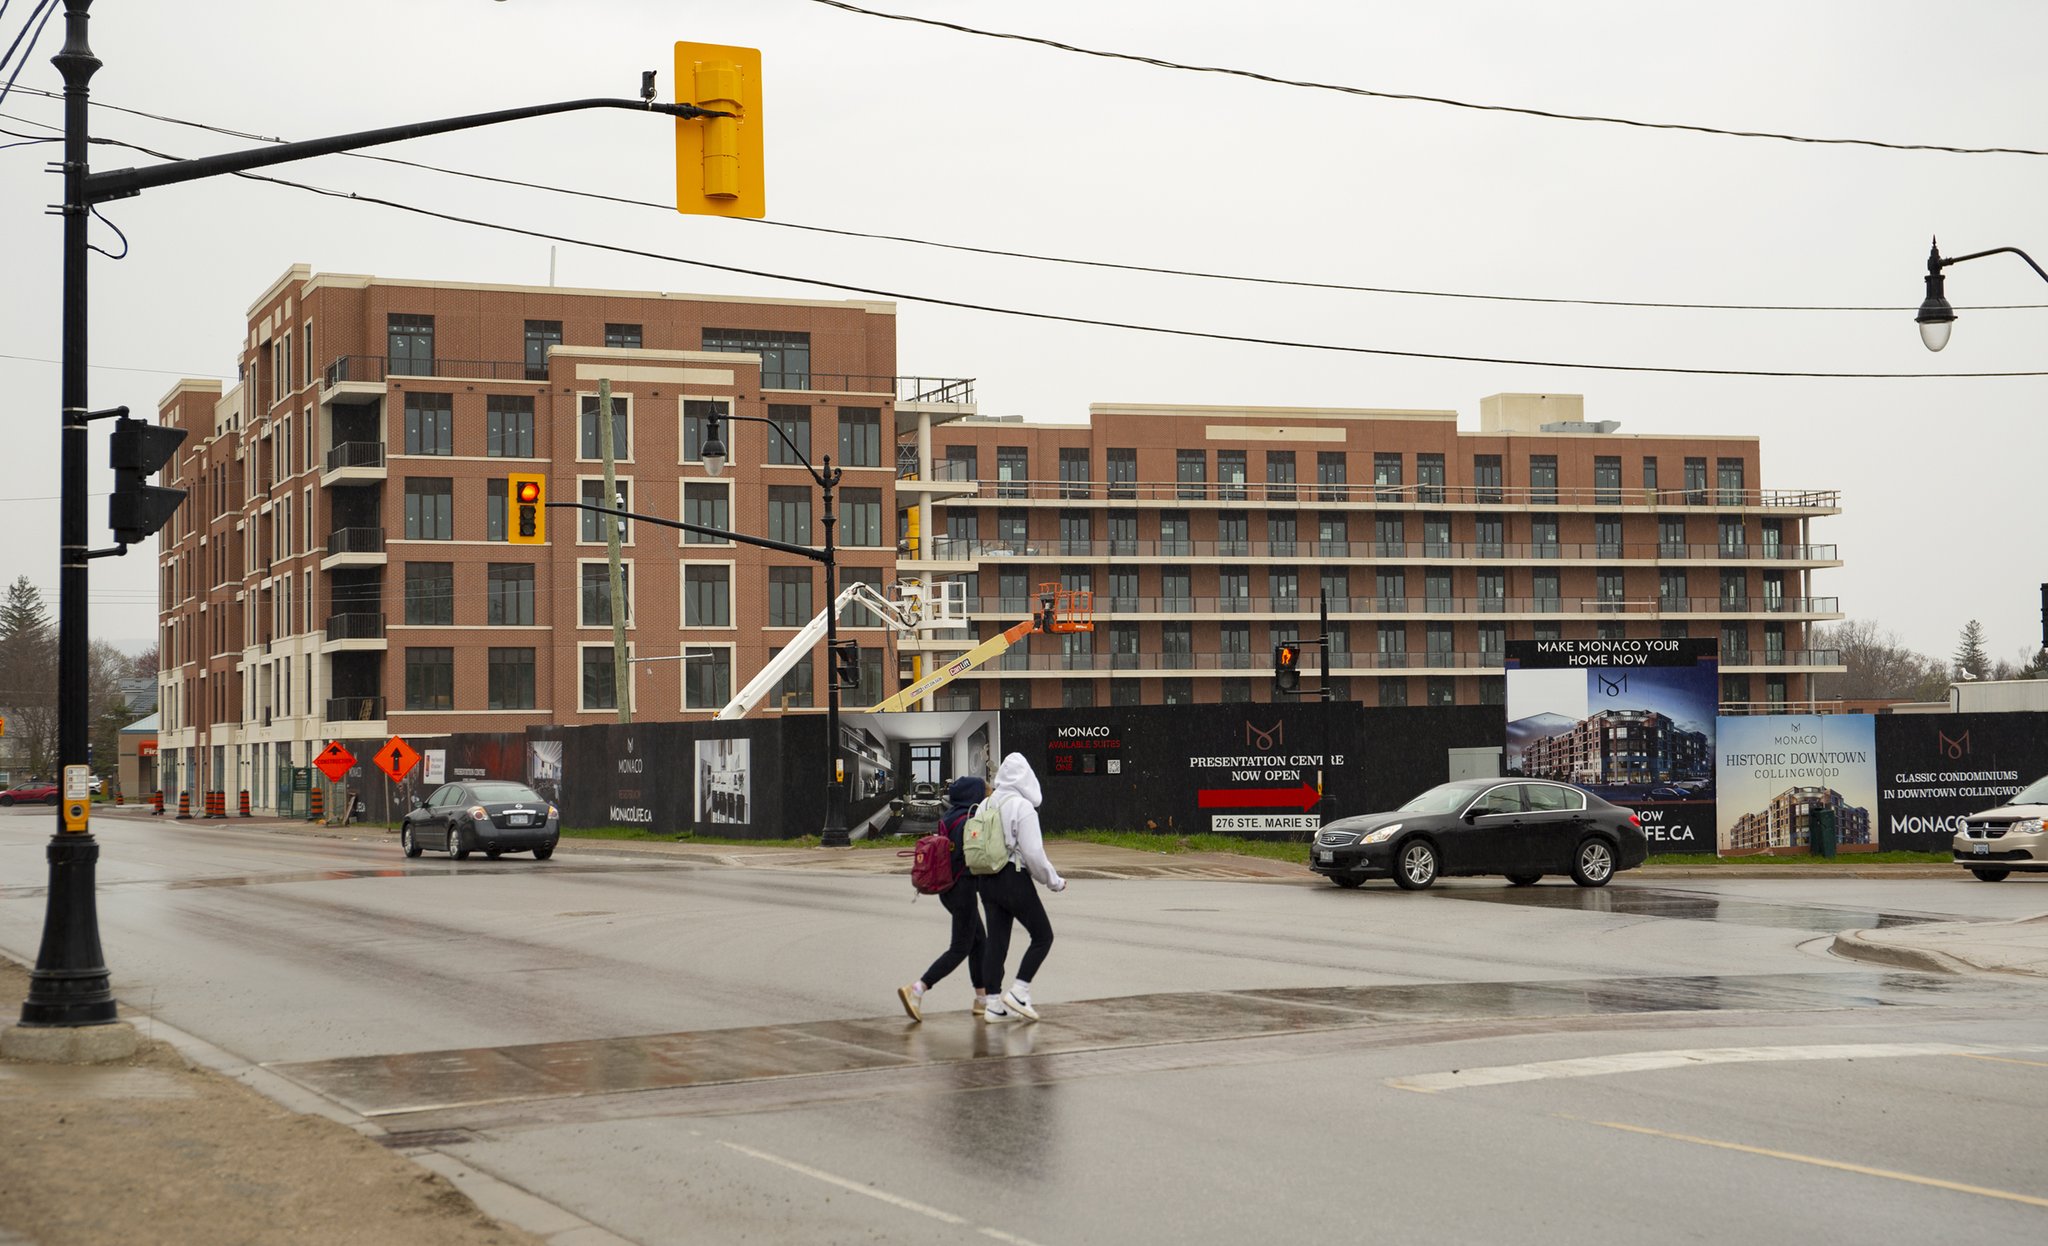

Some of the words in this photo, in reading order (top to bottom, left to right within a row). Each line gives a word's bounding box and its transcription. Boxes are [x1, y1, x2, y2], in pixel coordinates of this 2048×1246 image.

[1537, 641, 1574, 653] MAKE
[1579, 641, 1641, 652] MONACO
[1645, 640, 1679, 651] YOUR
[1569, 654, 1608, 666] HOME
[1613, 654, 1648, 665] NOW
[1058, 726, 1110, 737] MONACO
[1048, 740, 1091, 749] AVAILABLE
[1093, 739, 1120, 748] SUITES
[1775, 735, 1817, 745] MONACO
[1055, 755, 1073, 763] TAKE
[1189, 755, 1286, 767] PRESENTATION
[1726, 753, 1786, 766] HISTORIC
[1790, 751, 1866, 765] DOWNTOWN
[618, 758, 643, 773] MONACO
[1055, 763, 1073, 771] ONE
[1232, 770, 1261, 781] NOW
[1264, 770, 1300, 781] OPEN
[1754, 767, 1839, 779] COLLINGWOOD
[1895, 772, 1937, 783] CLASSIC
[1939, 770, 2018, 782] CONDOMINIUMS
[1884, 789, 1895, 799] IN
[1897, 787, 1957, 799] DOWNTOWN
[1958, 785, 2028, 797] COLLINGWOO
[1215, 818, 1234, 828] 276
[1237, 818, 1262, 828] STE.
[1265, 818, 1302, 828] MARIE
[1305, 817, 1320, 828] ST
[1891, 812, 1973, 834] MONACO
